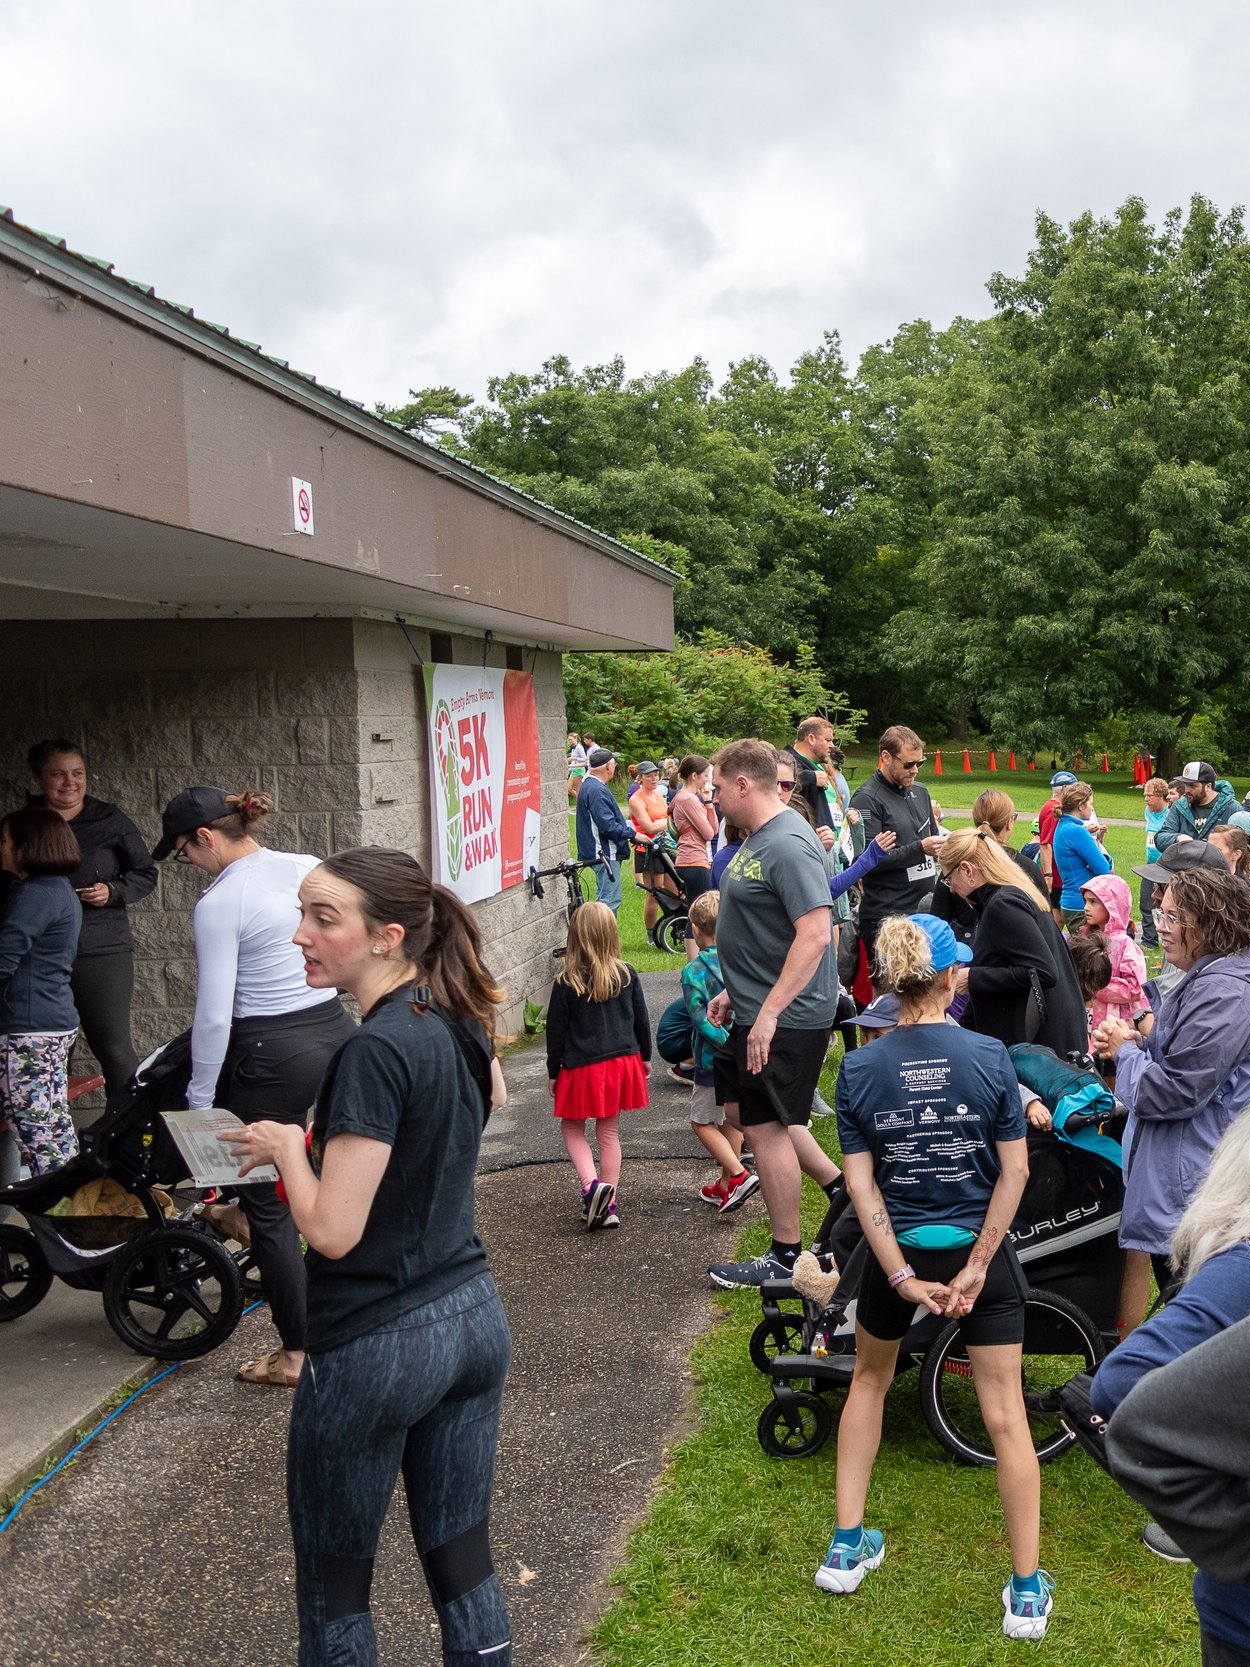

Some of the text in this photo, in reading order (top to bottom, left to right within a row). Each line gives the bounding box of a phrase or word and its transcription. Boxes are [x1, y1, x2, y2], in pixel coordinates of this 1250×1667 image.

[458, 712, 490, 787] 5K
[462, 786, 493, 838] RUN
[917, 859, 932, 872] 316
[900, 1067, 951, 1077] NORTHWESTERN
[905, 1073, 946, 1081] COUNSELING
[1009, 1201, 1099, 1243] BURLEY
